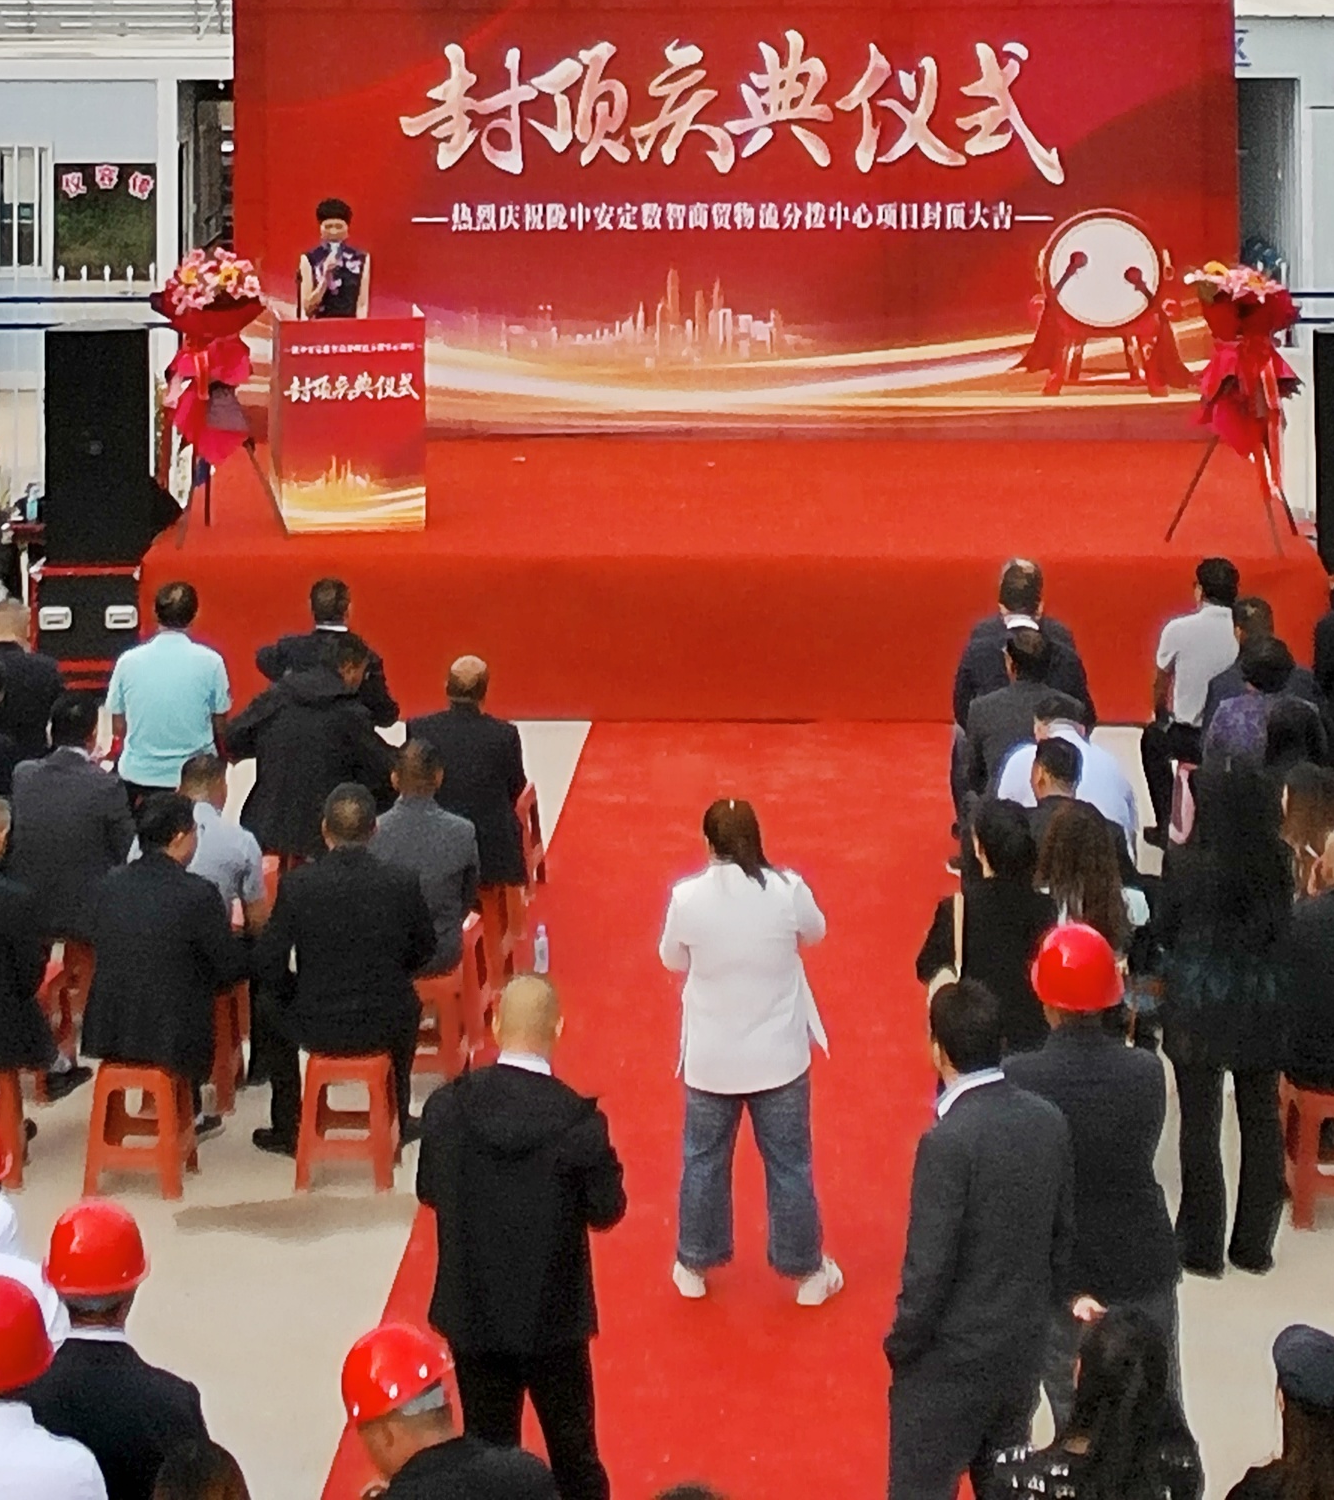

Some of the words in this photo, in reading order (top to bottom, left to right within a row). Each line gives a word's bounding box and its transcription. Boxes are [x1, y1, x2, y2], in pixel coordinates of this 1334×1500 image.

[400, 29, 1065, 186] 封顶庆典仪式
[283, 371, 420, 403] 封顶庆典仪式
